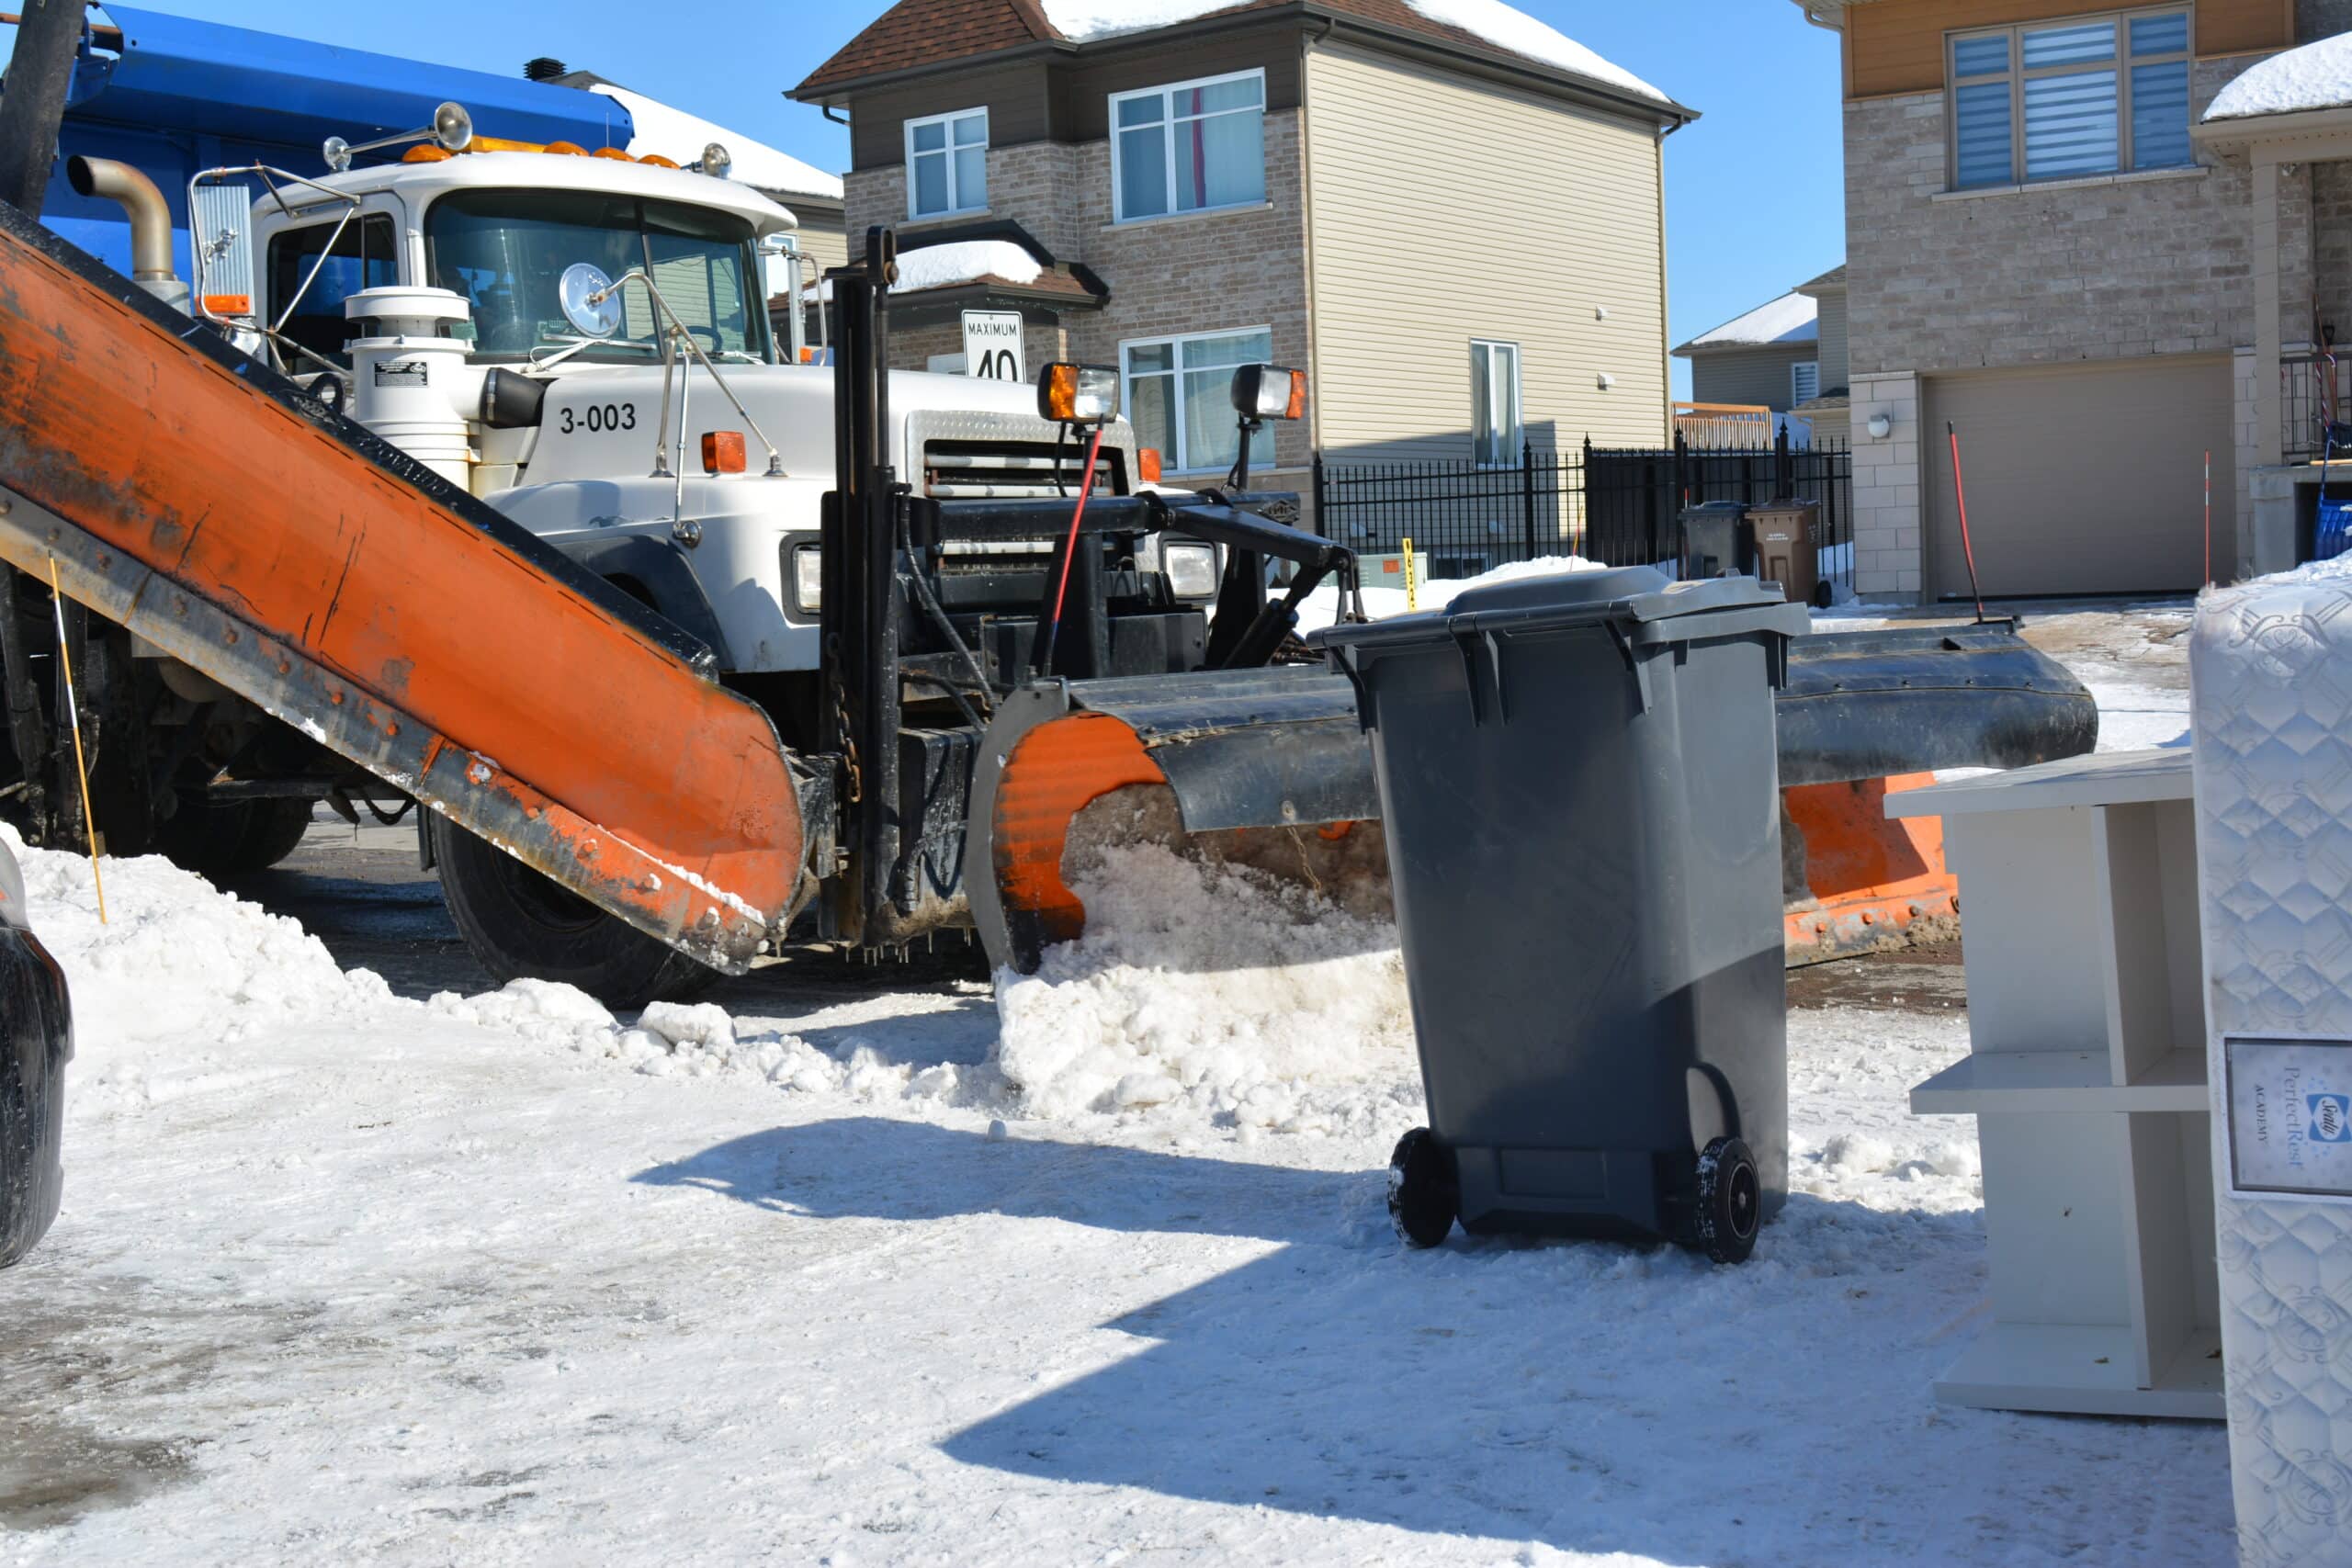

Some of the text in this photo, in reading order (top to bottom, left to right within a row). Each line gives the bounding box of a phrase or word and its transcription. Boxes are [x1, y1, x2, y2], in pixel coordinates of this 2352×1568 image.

[968, 322, 1017, 336] MAXIMUM
[560, 402, 637, 434] 3-003
[2254, 1084, 2268, 1144] ACADEMY
[2284, 1066, 2305, 1168] PerfectRest
[2320, 1100, 2339, 1135] Sealy
